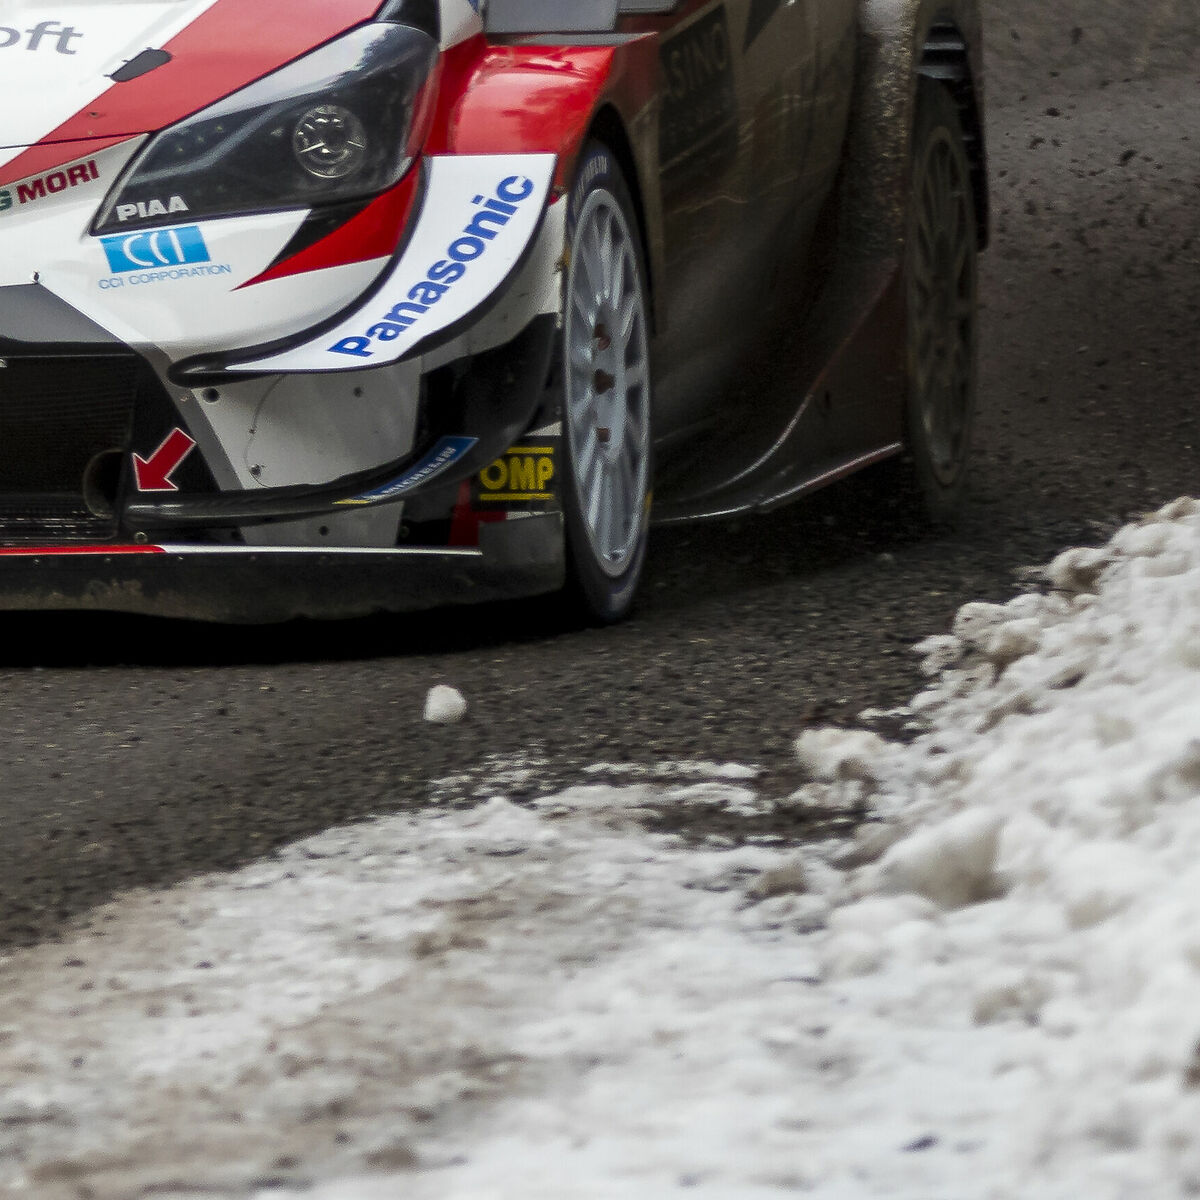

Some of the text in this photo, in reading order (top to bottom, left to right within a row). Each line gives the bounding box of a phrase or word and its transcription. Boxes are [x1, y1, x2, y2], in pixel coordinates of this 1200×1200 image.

[16, 159, 101, 204] MORI
[116, 195, 190, 222] PIAA
[98, 263, 233, 291] CCI CORPORATION
[326, 175, 535, 358] Panasonic
[479, 456, 555, 491] OMP
